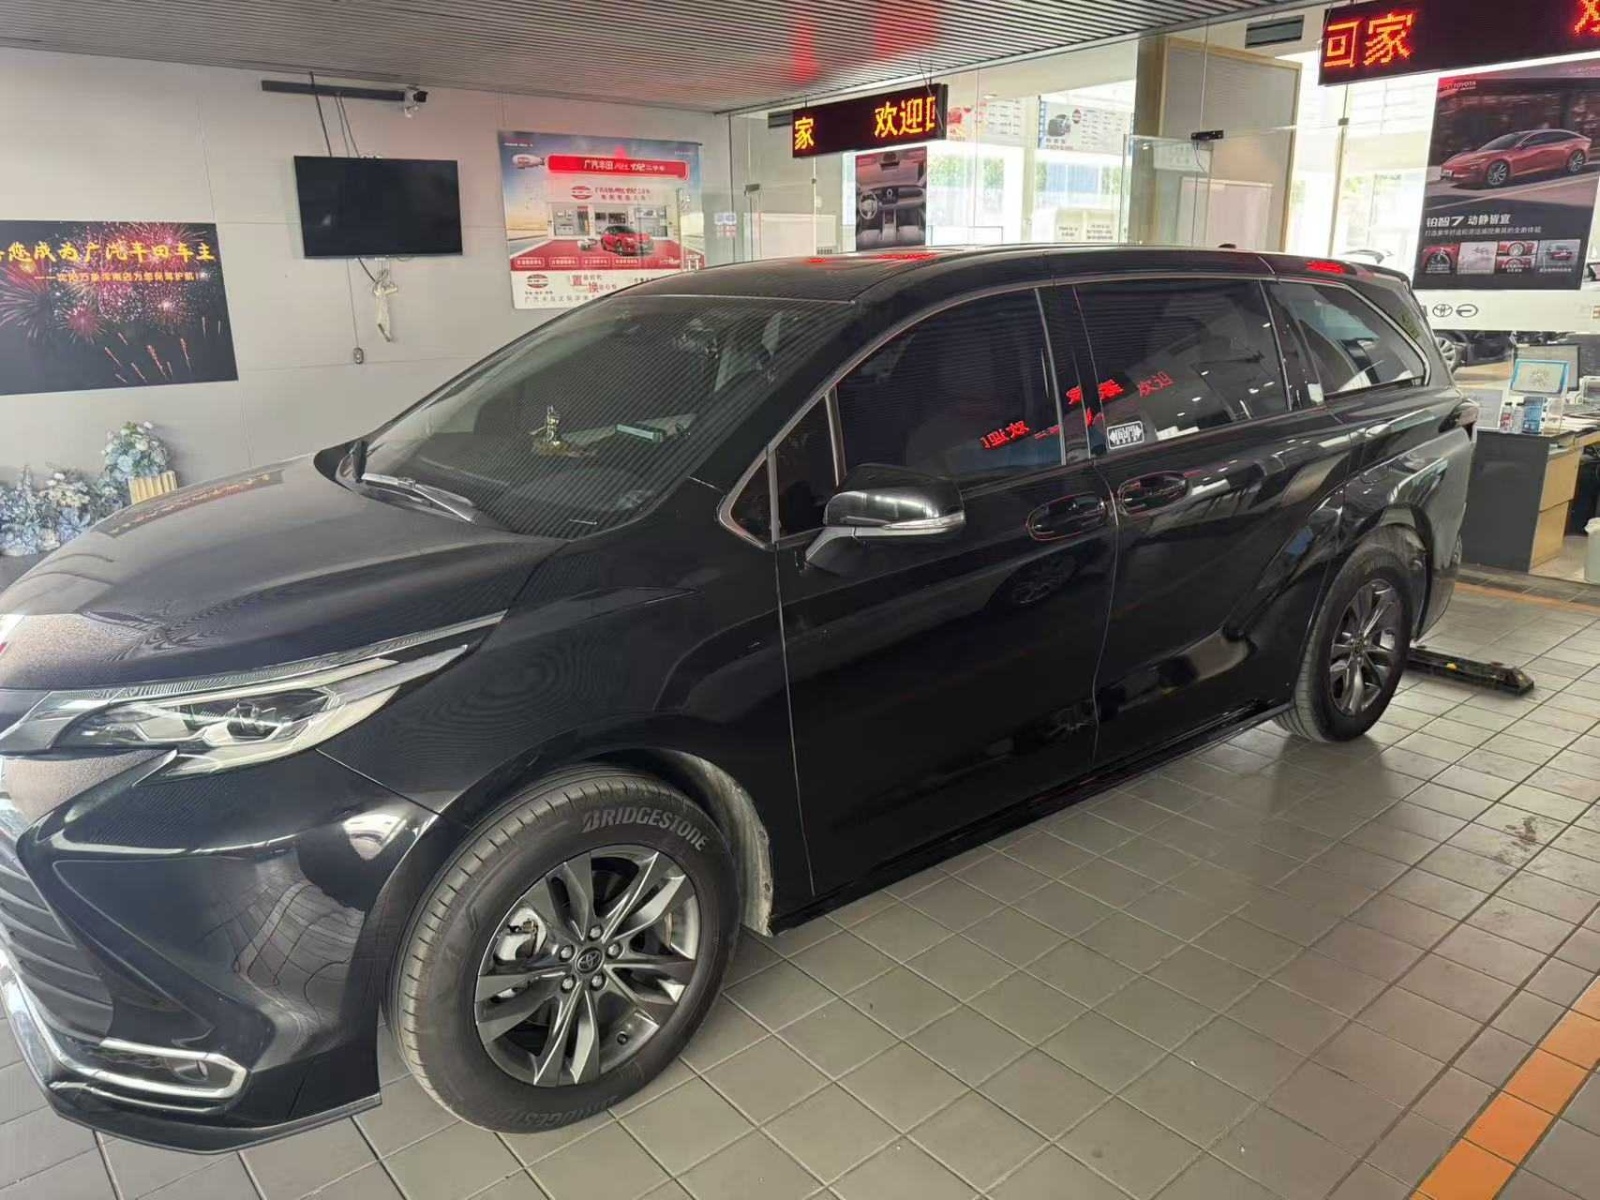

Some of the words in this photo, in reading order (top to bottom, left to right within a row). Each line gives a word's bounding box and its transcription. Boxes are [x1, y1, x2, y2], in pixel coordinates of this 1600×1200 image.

[1324, 12, 1416, 68] 回家
[794, 116, 815, 150] 家
[1426, 215, 1465, 228] 铂智7
[1468, 213, 1512, 226] 动静皆宜
[0, 240, 216, 263] 您成为广汽丰田车主
[582, 807, 709, 852] BRIDGESTONE
